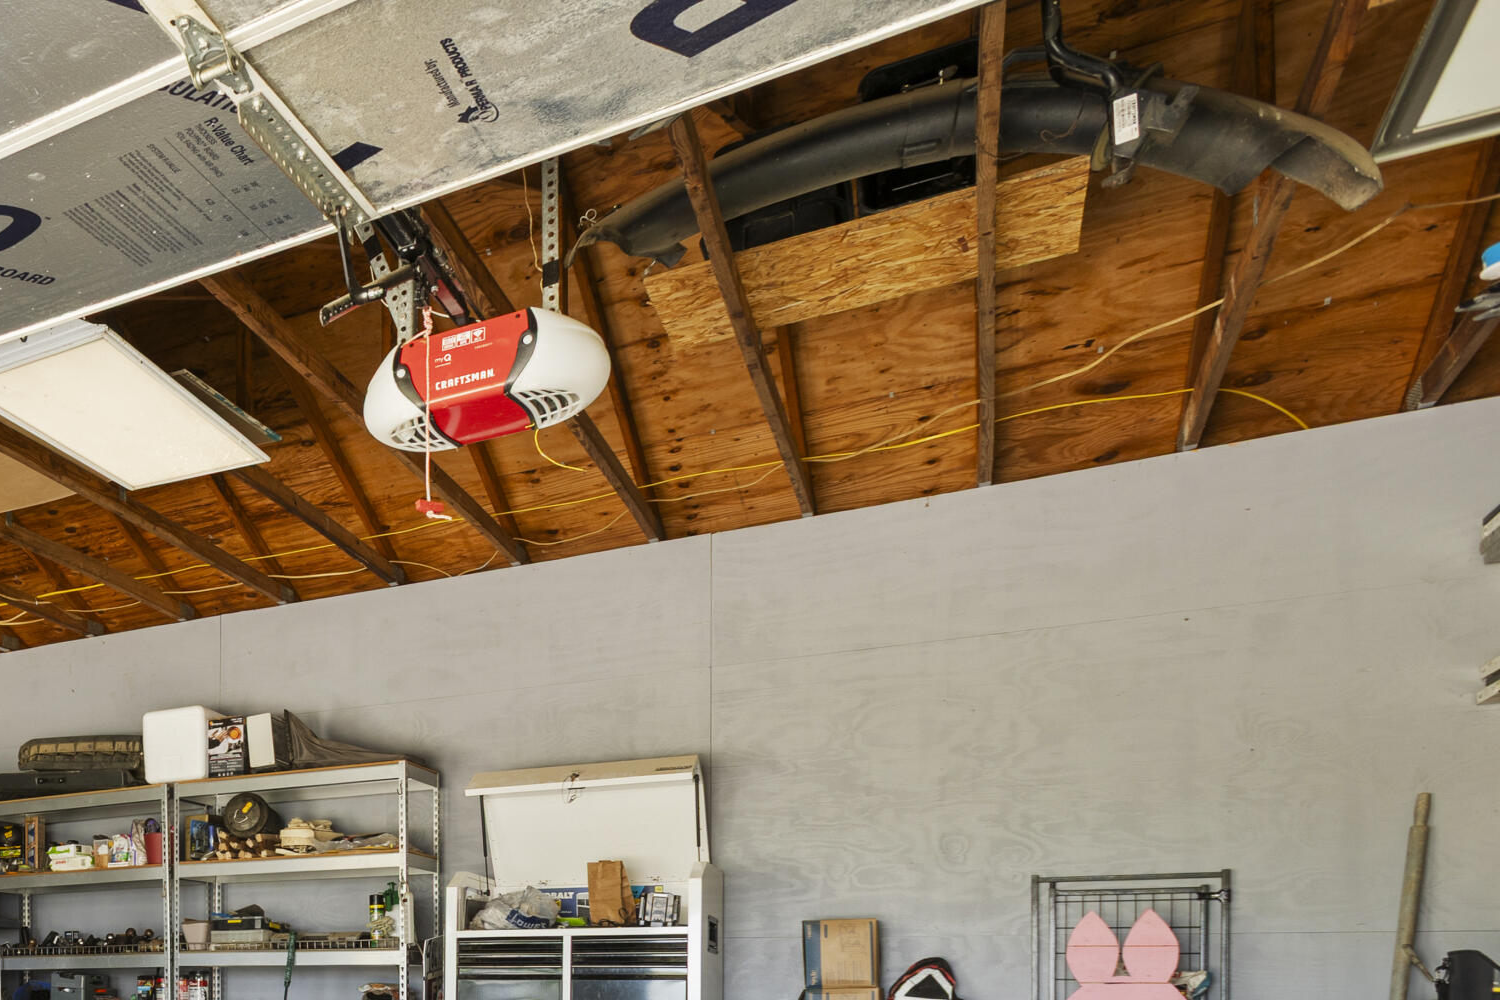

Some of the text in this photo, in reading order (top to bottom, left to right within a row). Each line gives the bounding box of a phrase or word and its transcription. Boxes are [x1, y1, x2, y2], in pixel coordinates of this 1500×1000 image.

[440, 38, 472, 79] PRODUCTS
[159, 80, 238, 114] ULATI
[469, 85, 492, 110] PERMA
[230, 144, 255, 166] Chart
[434, 353, 452, 363] myQ
[435, 368, 495, 391] CRAFTSMAN
